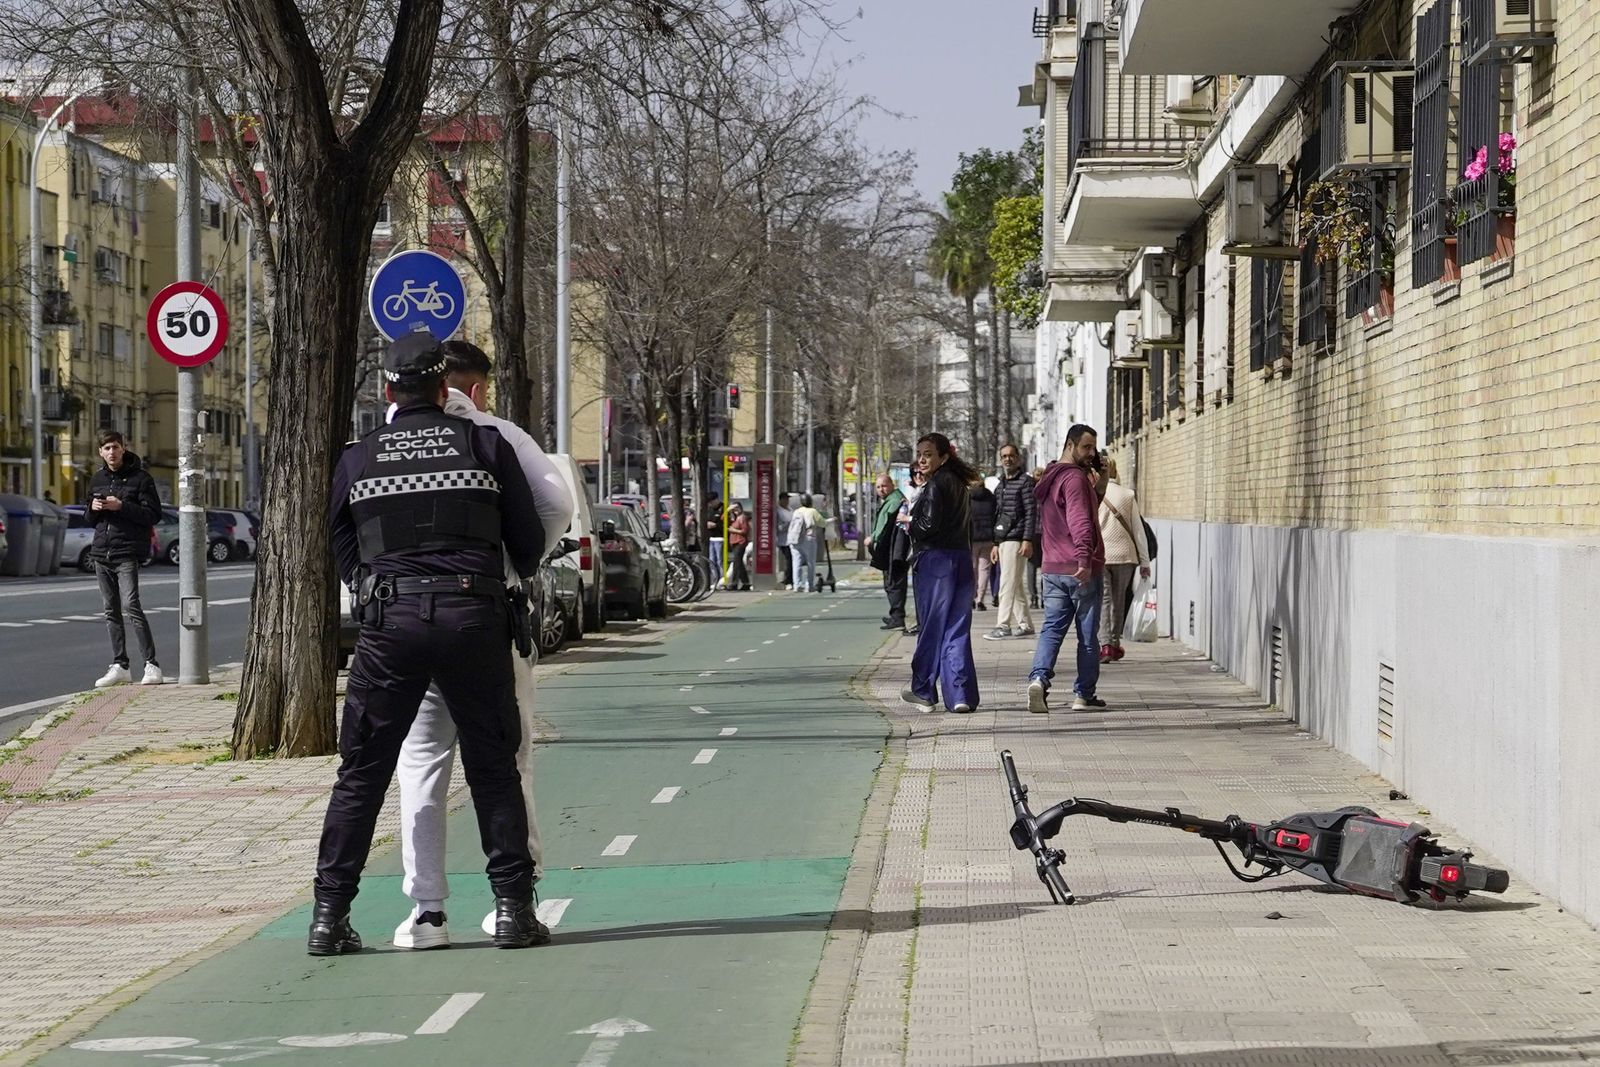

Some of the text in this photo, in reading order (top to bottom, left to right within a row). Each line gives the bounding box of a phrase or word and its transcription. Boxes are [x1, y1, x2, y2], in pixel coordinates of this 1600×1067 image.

[166, 310, 210, 338] 50
[379, 426, 455, 441] POLICÍA
[385, 438, 449, 450] LOCAL
[376, 447, 459, 462] SEVILLA
